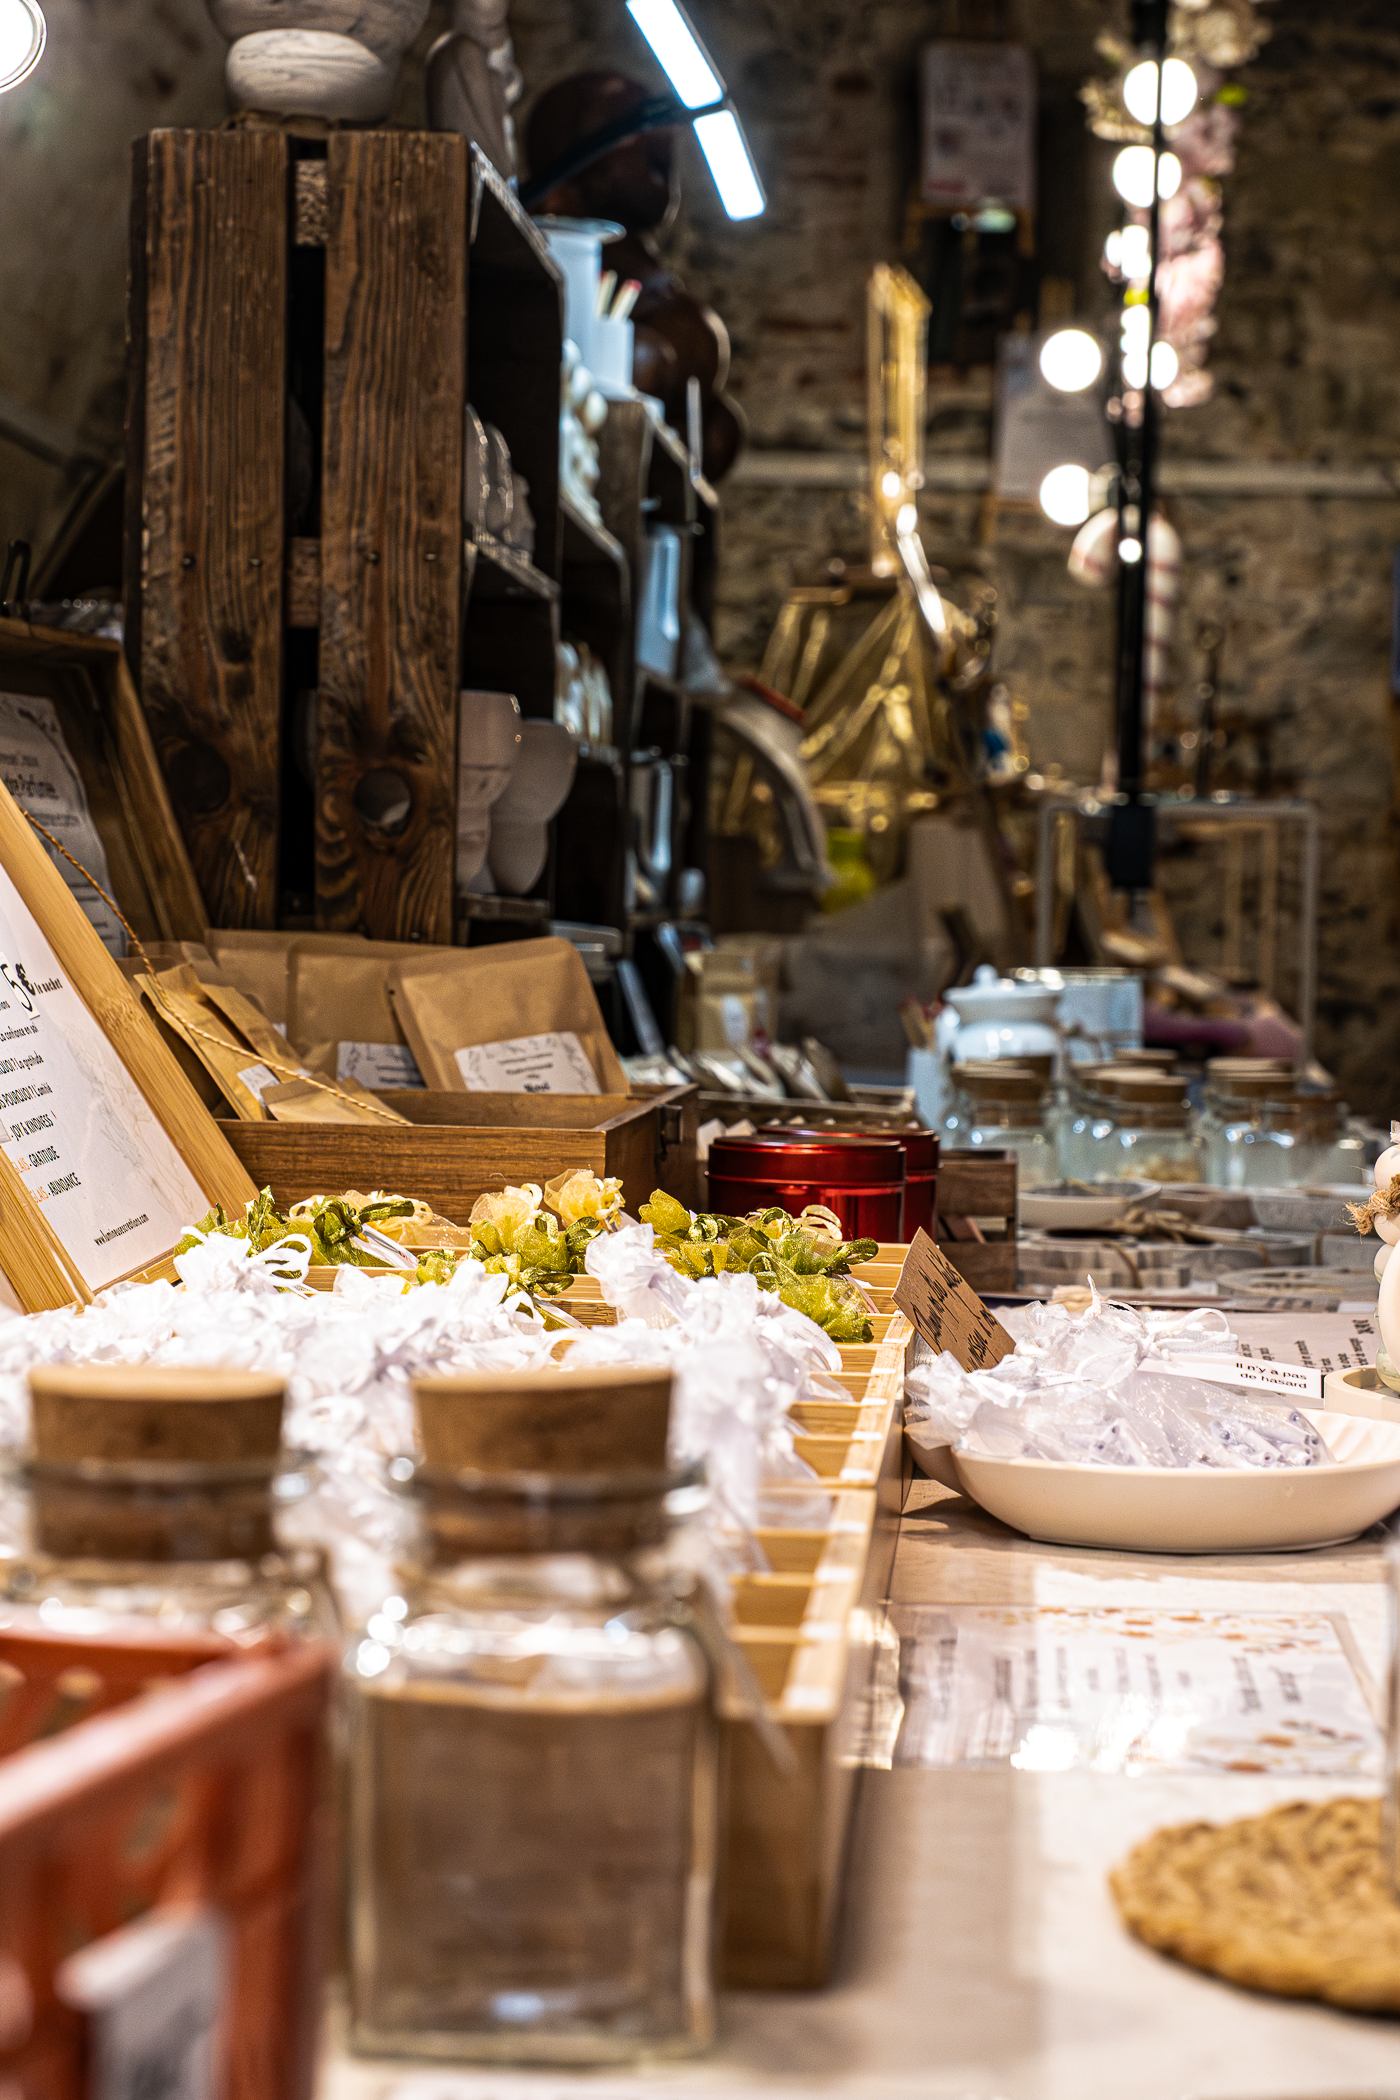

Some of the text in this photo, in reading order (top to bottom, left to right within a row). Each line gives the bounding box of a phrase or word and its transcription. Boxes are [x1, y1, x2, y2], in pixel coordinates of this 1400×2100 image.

[24, 1113, 54, 1133] KINDNESS
[28, 1145, 60, 1167] GRATITUDE
[46, 1171, 82, 1196] ABUNDANCE
[1247, 1365, 1266, 1374] n'y
[1282, 1371, 1307, 1380] pas
[1261, 1375, 1307, 1389] hasard
